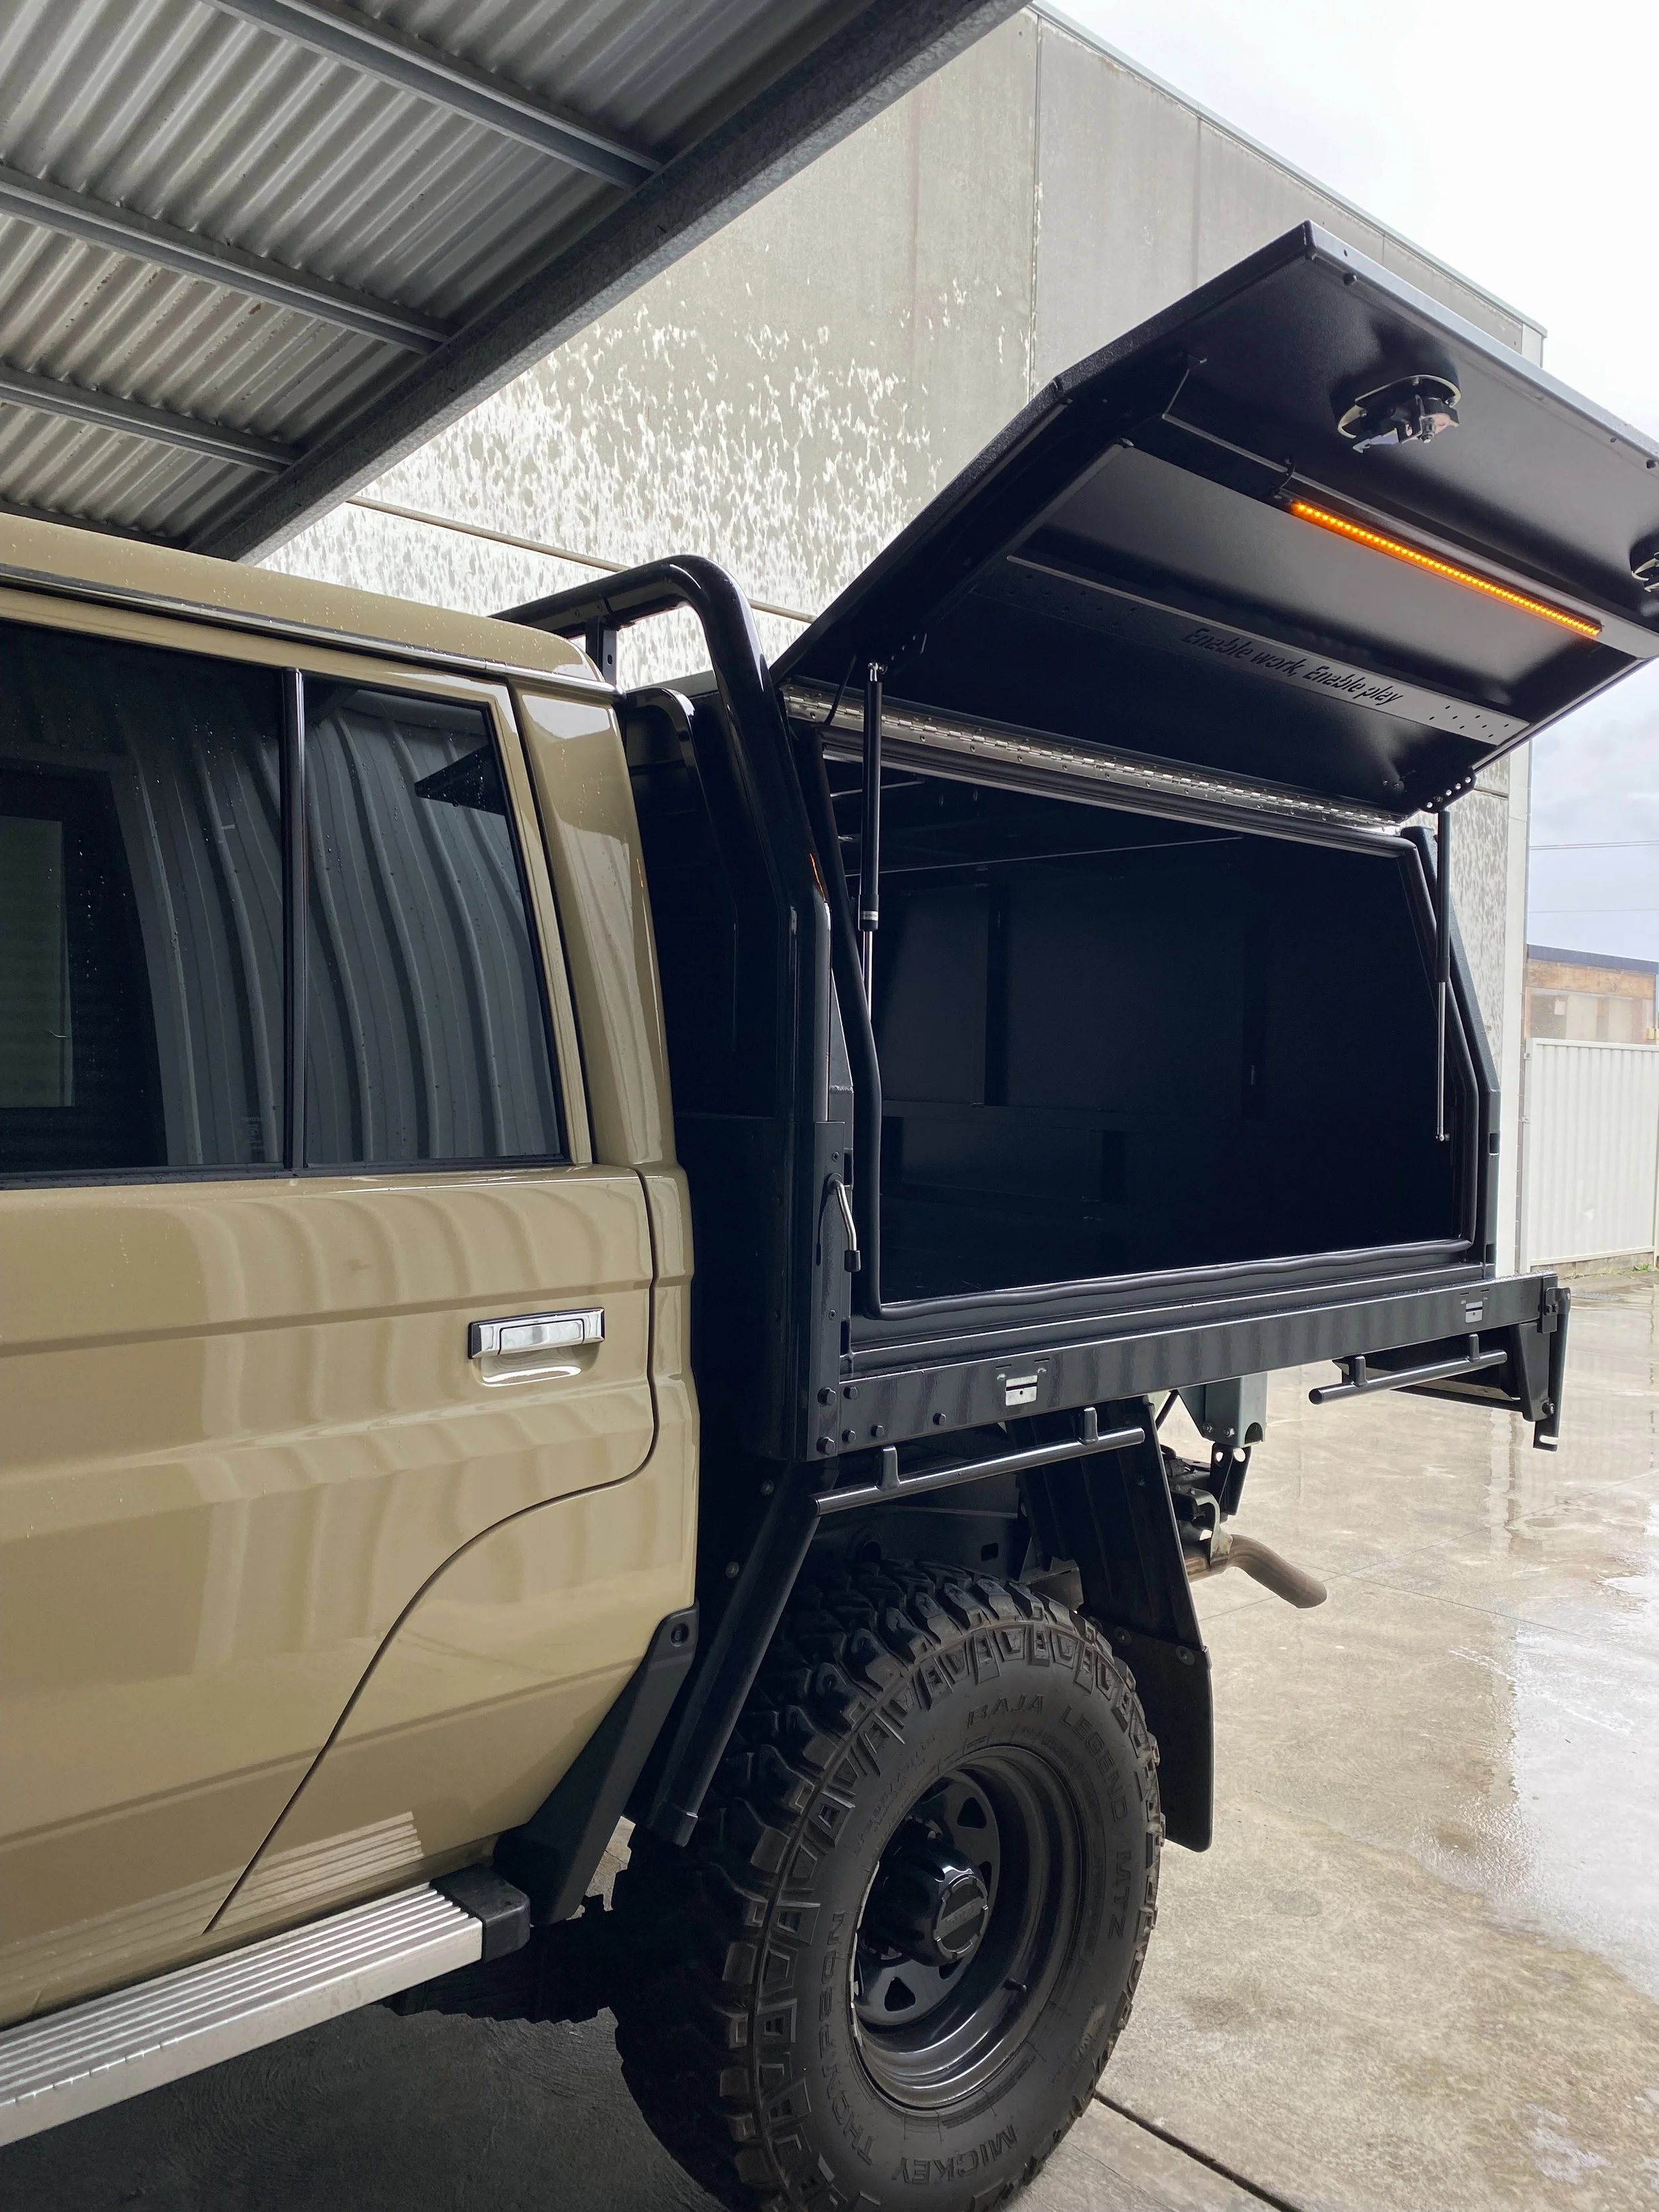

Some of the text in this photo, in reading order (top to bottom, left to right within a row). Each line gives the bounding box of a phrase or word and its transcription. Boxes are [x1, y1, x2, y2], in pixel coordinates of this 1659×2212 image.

[1181, 628, 1404, 705] Enable work, Enable play
[968, 1694, 1133, 1940] BAJA LEGEND MTZ
[819, 1910, 875, 2166] THOMPSON
[892, 2124, 1018, 2185] MICKEY
